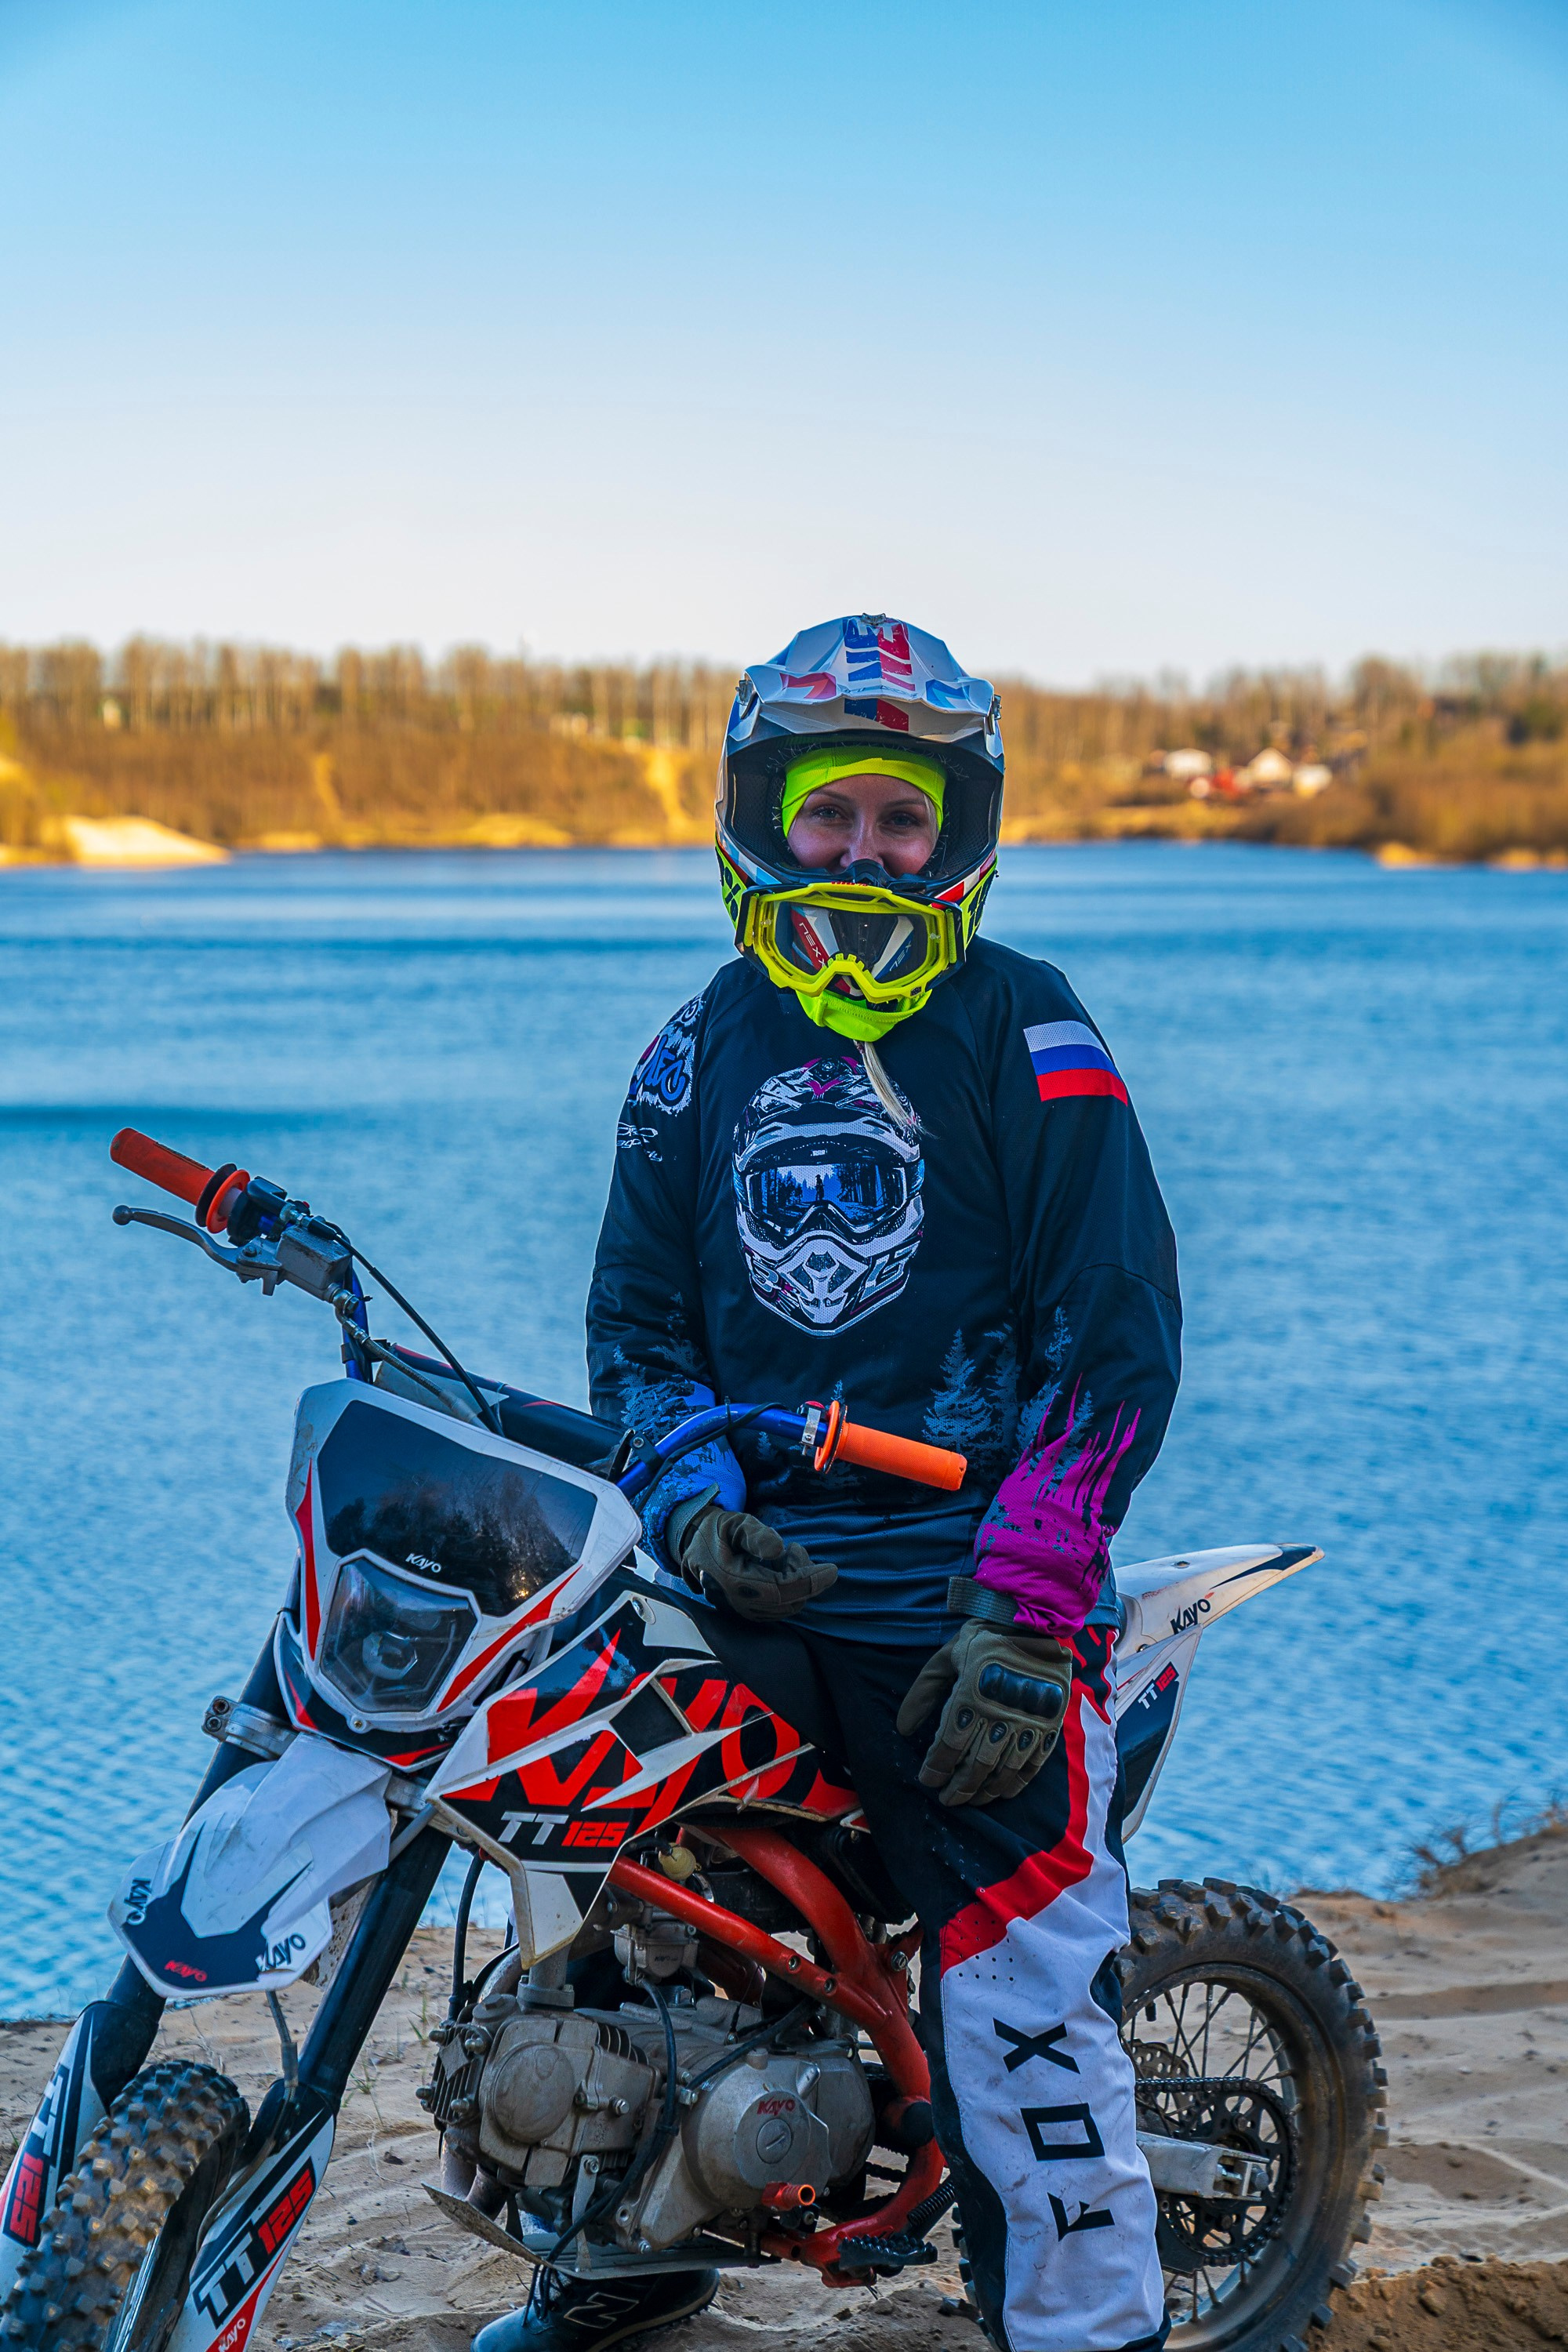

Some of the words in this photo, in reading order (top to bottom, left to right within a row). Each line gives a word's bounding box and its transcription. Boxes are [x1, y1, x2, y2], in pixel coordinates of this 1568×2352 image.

[405, 1553, 441, 1573] KAYO
[1171, 1598, 1211, 1635] KAYO
[123, 1877, 151, 1926] KAYO
[164, 1959, 208, 1983] KAYO
[255, 1933, 307, 1973] KAYO
[757, 2096, 796, 2116] KAYO
[993, 2017, 1116, 2242] FOX
